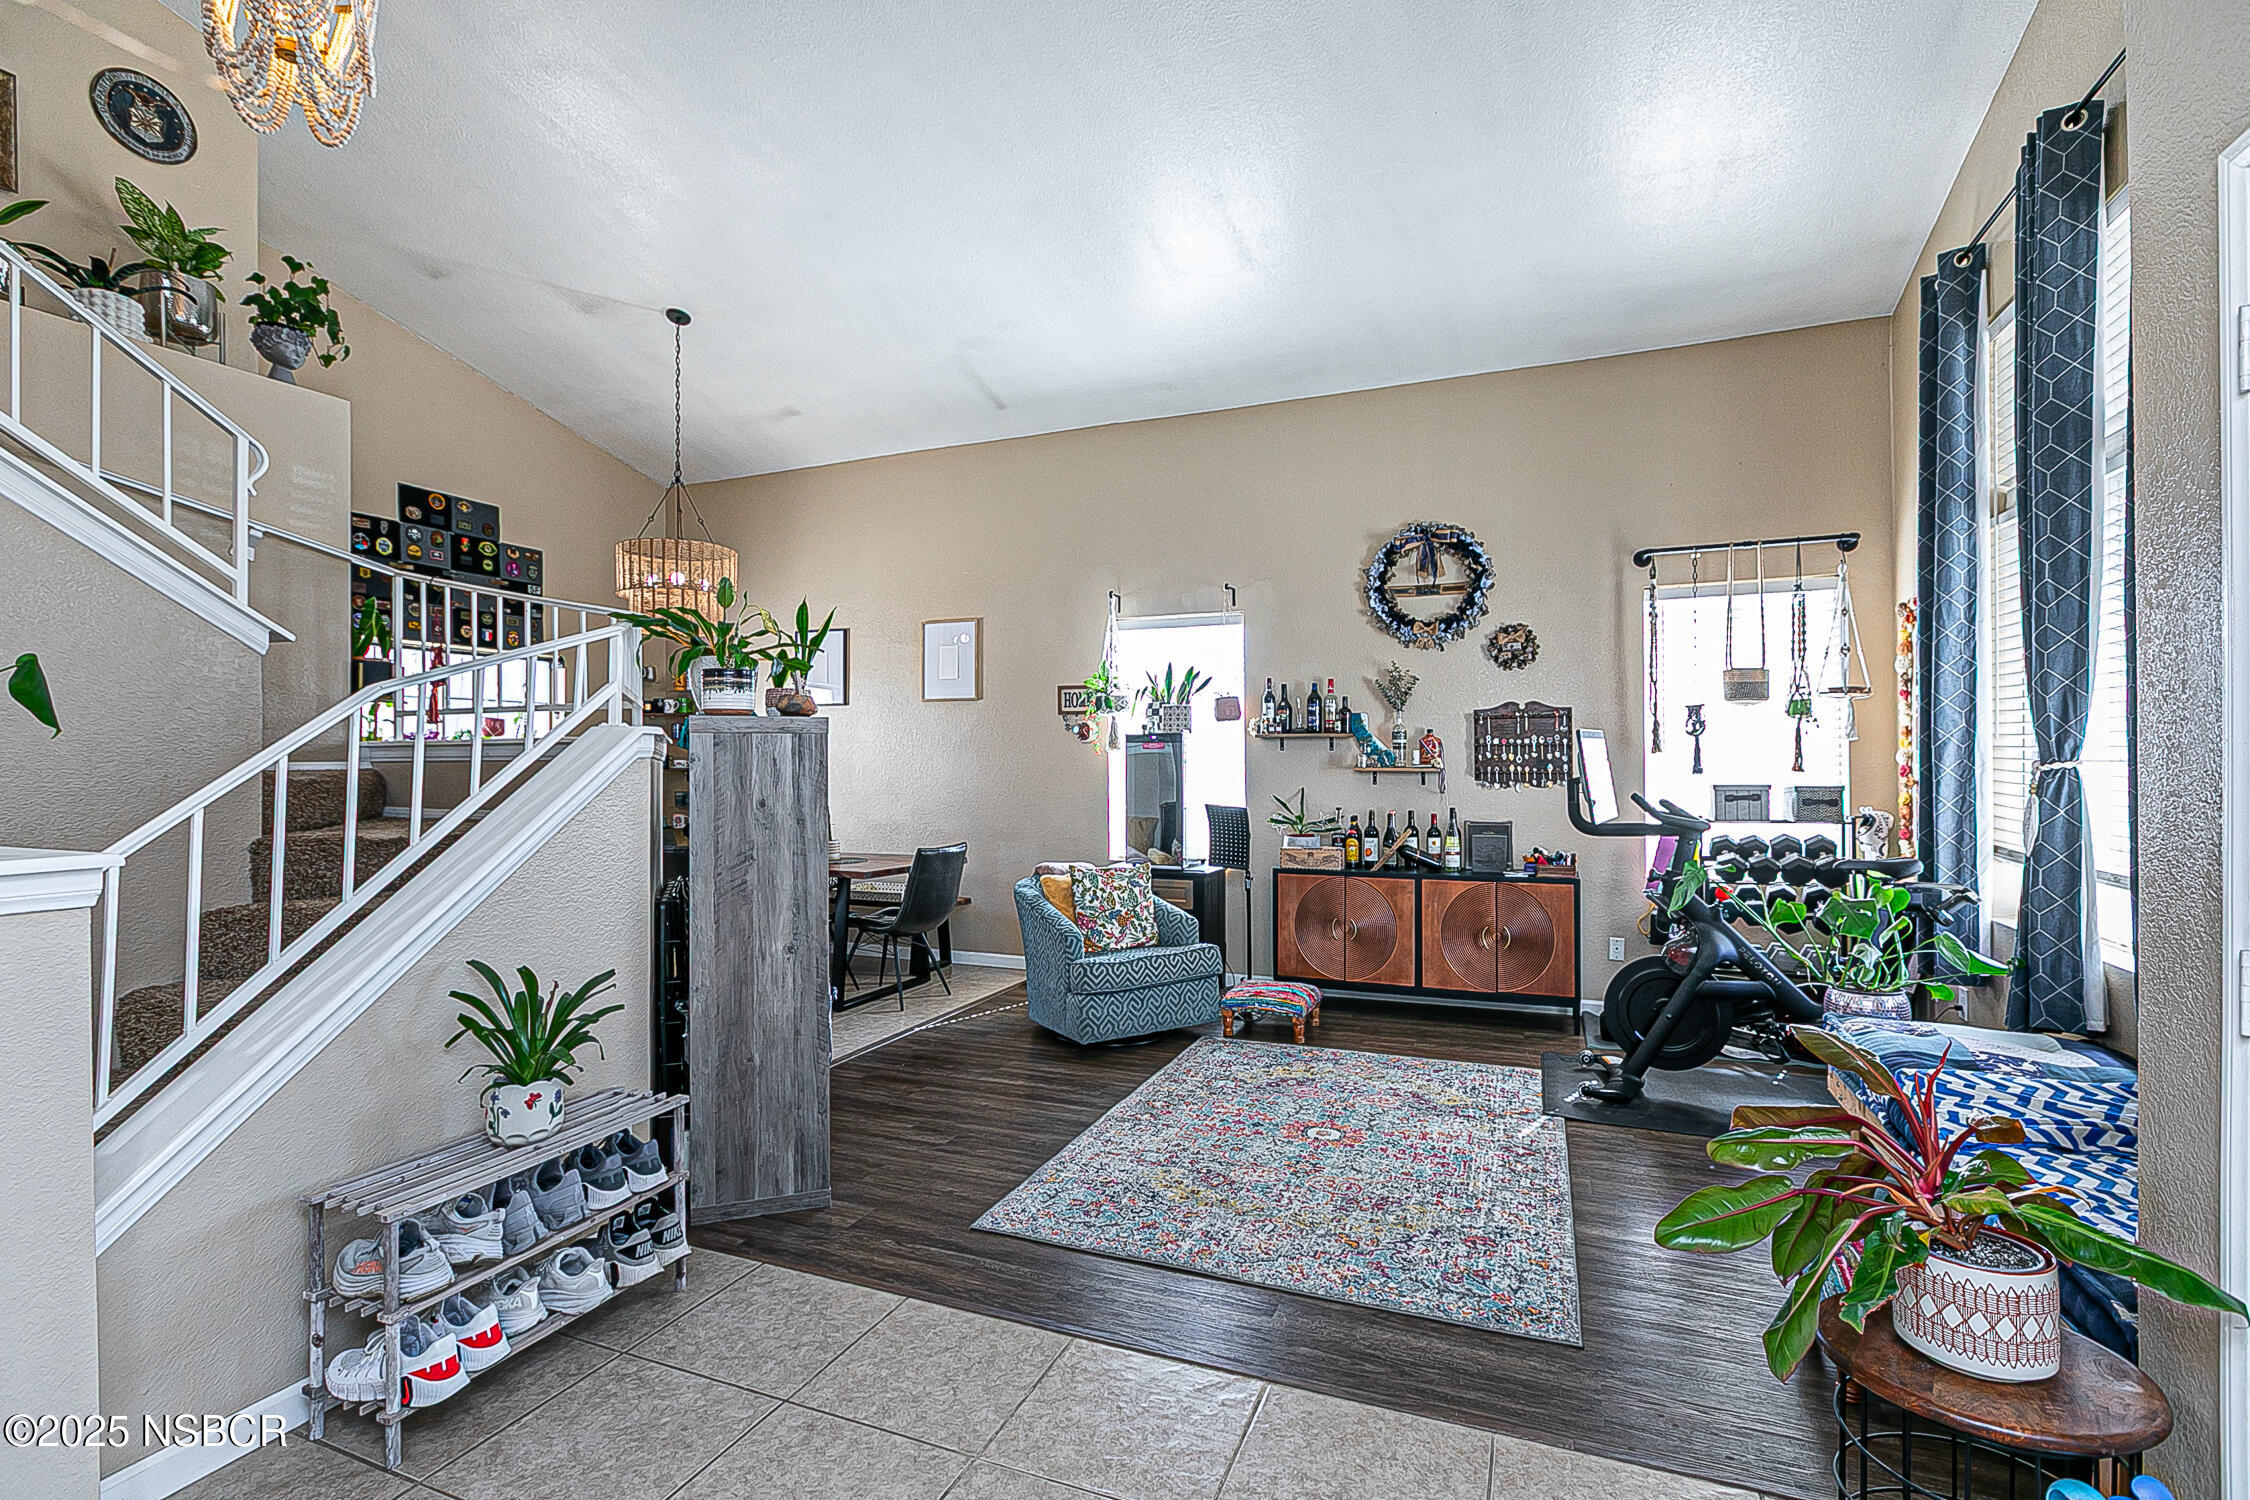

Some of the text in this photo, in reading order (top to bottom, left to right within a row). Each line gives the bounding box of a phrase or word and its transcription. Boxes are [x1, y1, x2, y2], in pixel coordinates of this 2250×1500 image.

[1738, 946, 1782, 985] PELOTON
[663, 1224, 682, 1244] NIK
[635, 1240, 653, 1259] NIK
[495, 1296, 522, 1310] OKA
